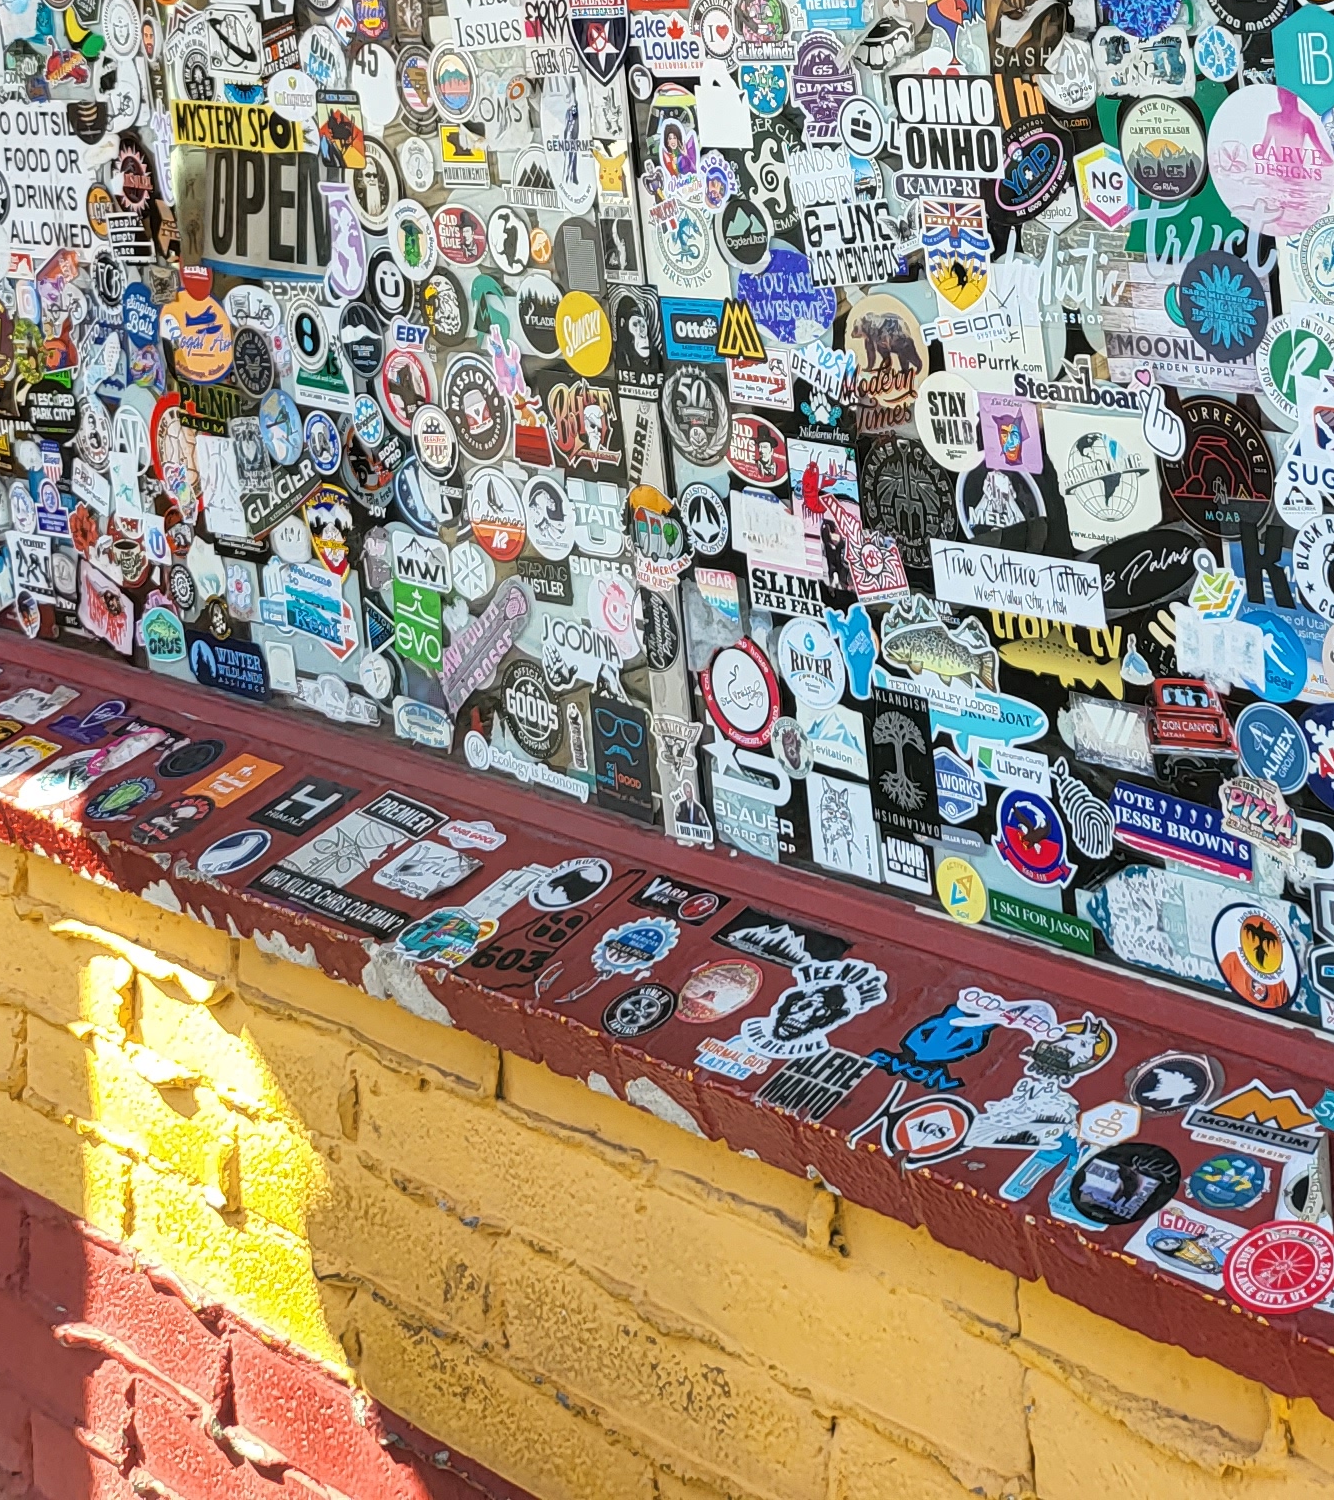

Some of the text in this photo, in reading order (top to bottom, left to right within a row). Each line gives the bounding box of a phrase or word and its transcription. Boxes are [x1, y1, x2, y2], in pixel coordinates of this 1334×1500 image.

[456, 14, 522, 51] Issues
[899, 76, 995, 128] OHNO
[175, 101, 246, 145] MYSTERY
[5, 147, 81, 175] FOOD OR
[906, 125, 999, 172] ONHO
[1251, 145, 1323, 166] CARVE
[14, 184, 78, 212] DRINKS
[1092, 170, 1123, 192] NG
[9, 221, 91, 250] ALLOWED
[947, 350, 1043, 374] ThePurrk.com
[1205, 509, 1241, 524] MOAB
[397, 553, 445, 588] MWI
[396, 619, 440, 664] evo
[789, 655, 833, 676] RIVER
[506, 681, 559, 732] GOODS
[887, 680, 998, 716] TETON VALLEY LODGE
[995, 761, 1042, 781] Library
[373, 792, 434, 832] PREMIER
[1114, 784, 1153, 809] VOTE
[1115, 805, 1250, 861] JESSE BROWN'S
[866, 1052, 965, 1093] evolv
[1197, 1116, 1317, 1149] MOMENTUM
